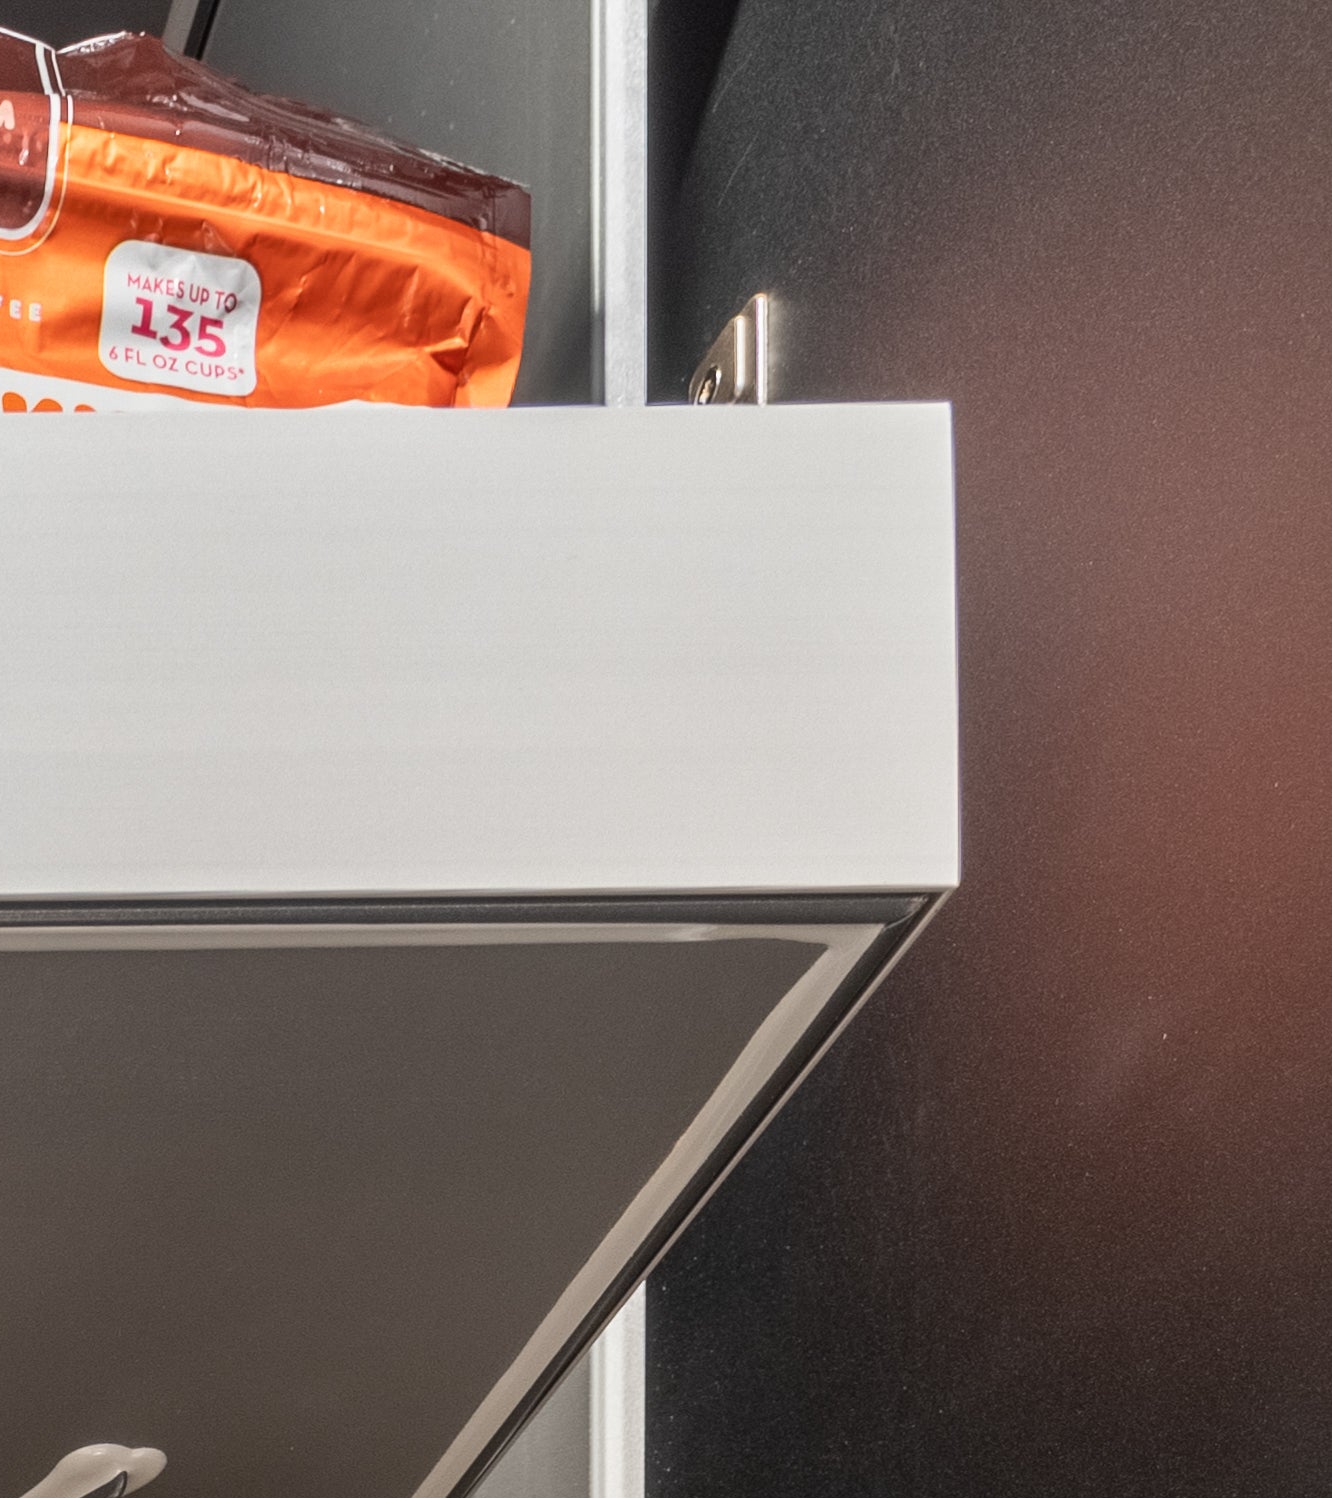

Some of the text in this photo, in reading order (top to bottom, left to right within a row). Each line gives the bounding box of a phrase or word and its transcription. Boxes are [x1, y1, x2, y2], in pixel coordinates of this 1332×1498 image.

[127, 273, 238, 314] MAKES UP TO
[131, 297, 226, 358] 135
[109, 346, 179, 372] 6 FL OZ
